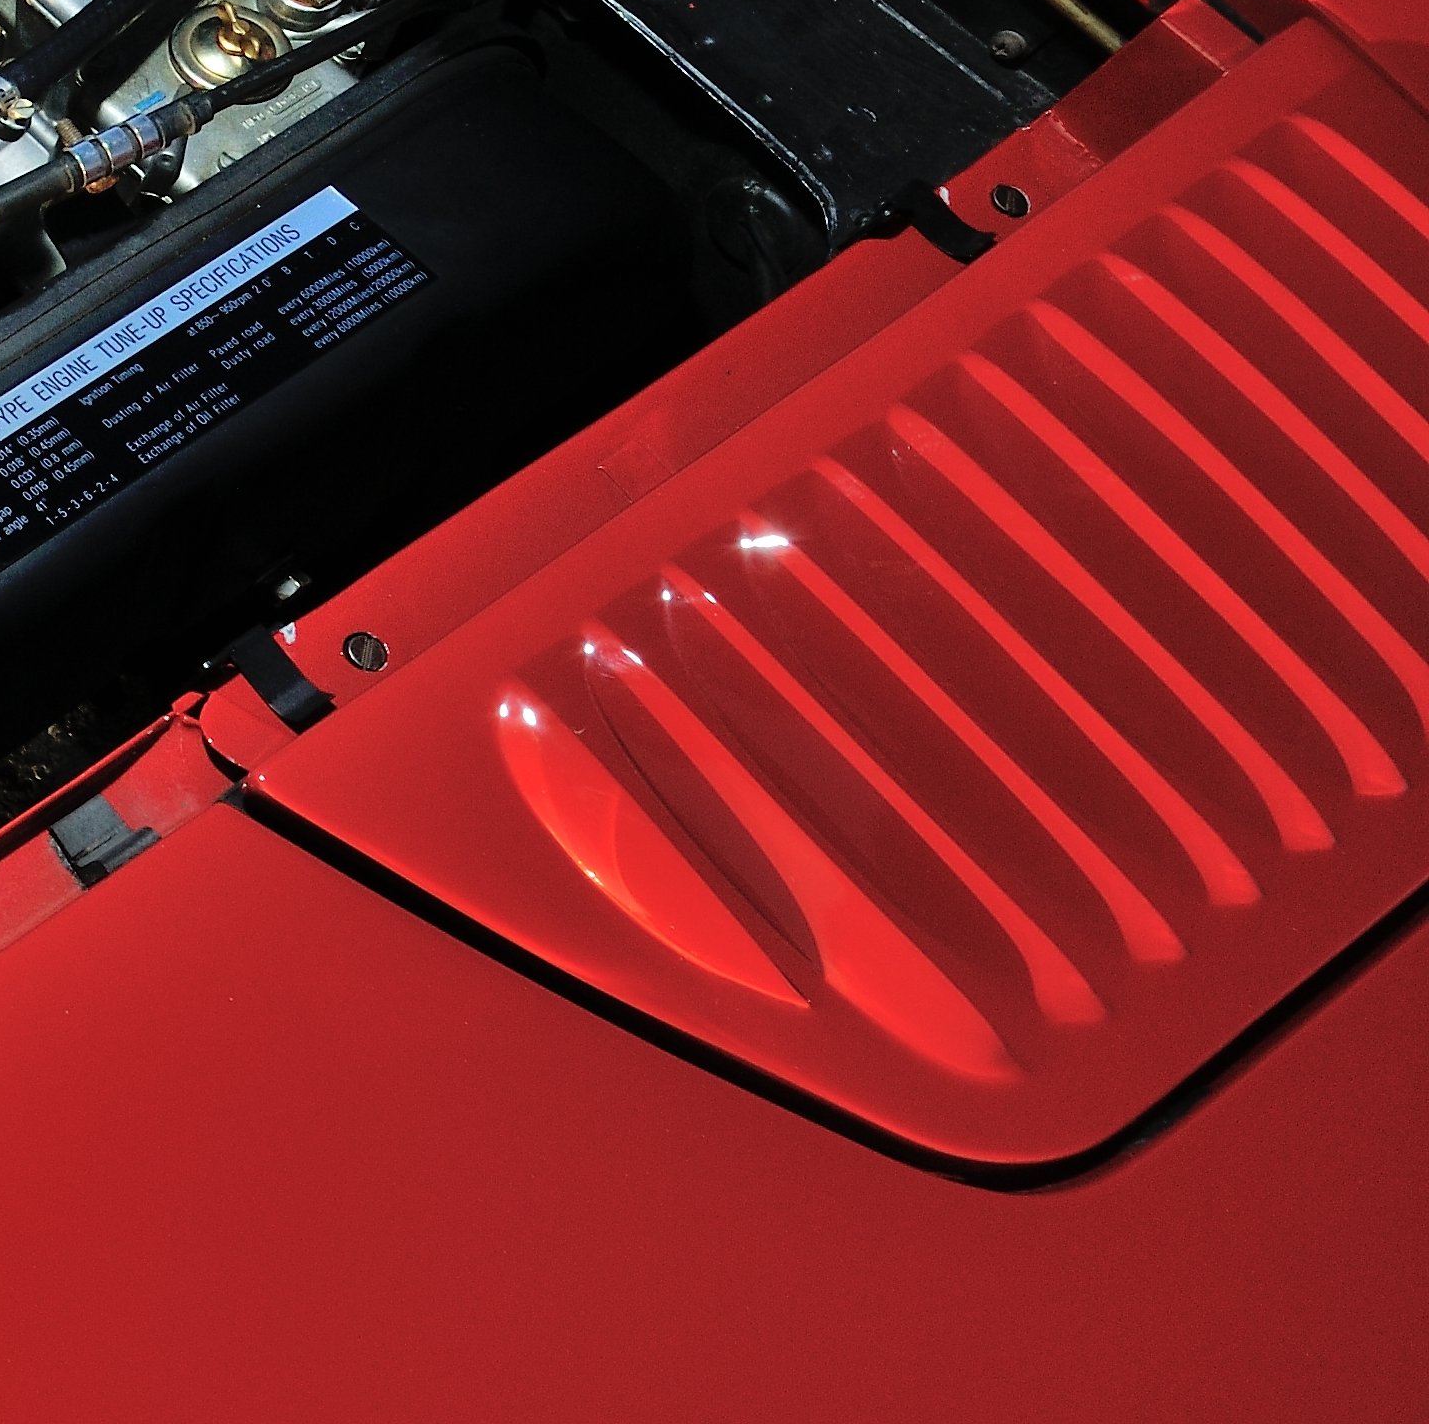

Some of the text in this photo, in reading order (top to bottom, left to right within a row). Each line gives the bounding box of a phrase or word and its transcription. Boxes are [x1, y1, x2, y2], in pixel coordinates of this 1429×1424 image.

[31, 354, 97, 401] ENGINE
[93, 306, 166, 357] TUNE-UP
[170, 224, 299, 311] SPECIFICATIONS
[101, 402, 141, 427] Dusting
[142, 391, 153, 402] of
[155, 382, 170, 393] Air
[172, 363, 198, 382] Filter
[209, 336, 238, 357] Paved
[241, 320, 262, 338] road
[277, 297, 302, 314] every
[344, 239, 390, 270] (10000km)
[220, 249, 402, 369] Dusty road every 3000Miles (5000km)
[78, 382, 112, 405] Ignition
[110, 363, 143, 383] Timing
[126, 420, 172, 451] Exchange
[173, 409, 184, 420] of
[185, 400, 200, 412] Air
[200, 383, 227, 402] Filter
[302, 318, 326, 336] every
[138, 271, 427, 463] Exchange of Oil Filter every 6000Miles (10000km)
[16, 416, 59, 446] (0.35mm)
[28, 427, 70, 457] (0.45mm)
[51, 450, 94, 481] (0.45mm)
[3, 515, 28, 534] angle
